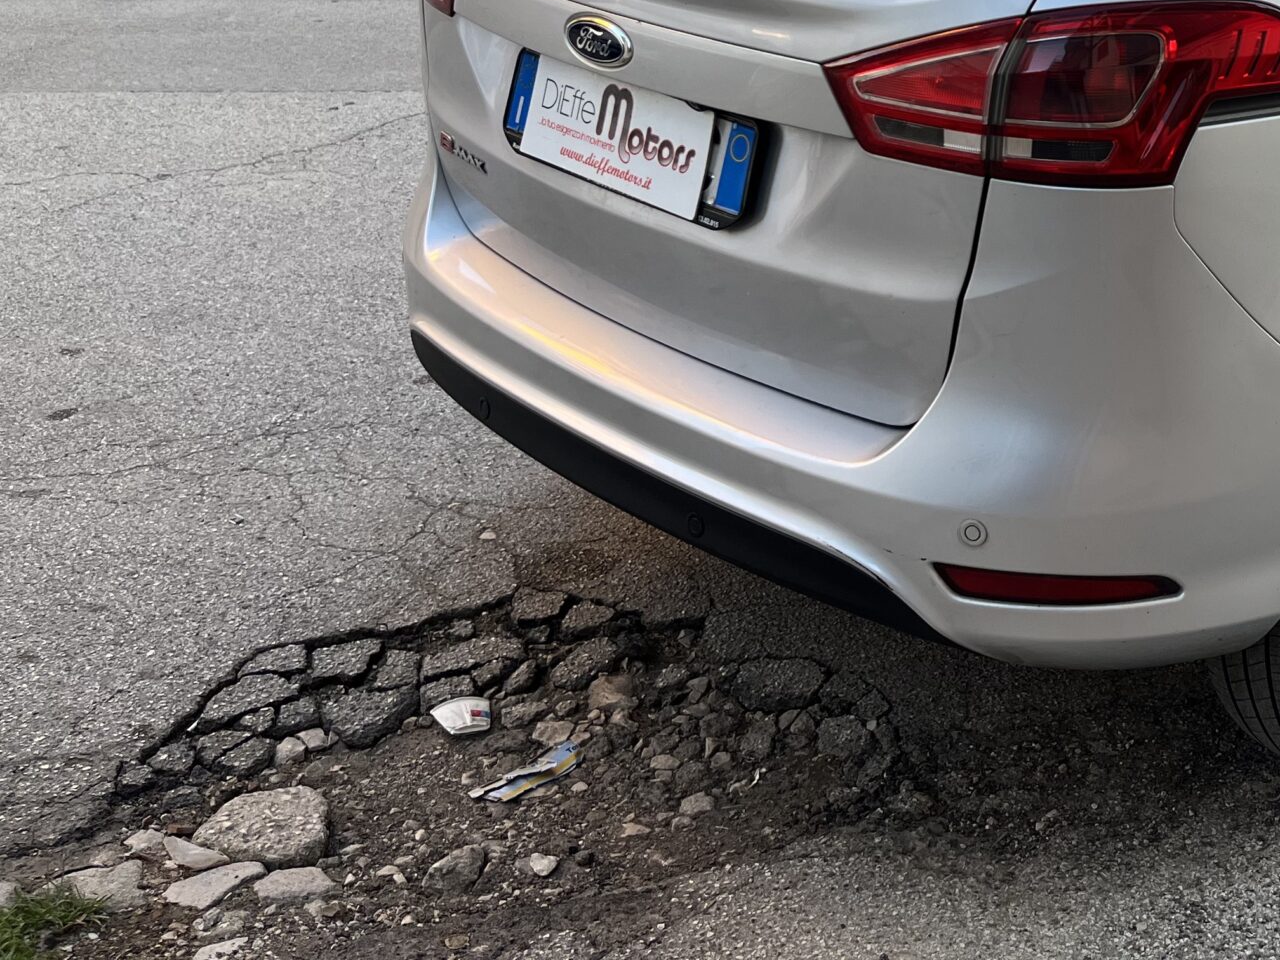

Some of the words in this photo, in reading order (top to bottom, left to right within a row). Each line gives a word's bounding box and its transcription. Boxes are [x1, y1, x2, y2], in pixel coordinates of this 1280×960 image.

[576, 26, 612, 57] Ford
[541, 78, 596, 124] DiEffe
[595, 84, 696, 174] Motors
[560, 145, 653, 190] www.dieffemotors.it
